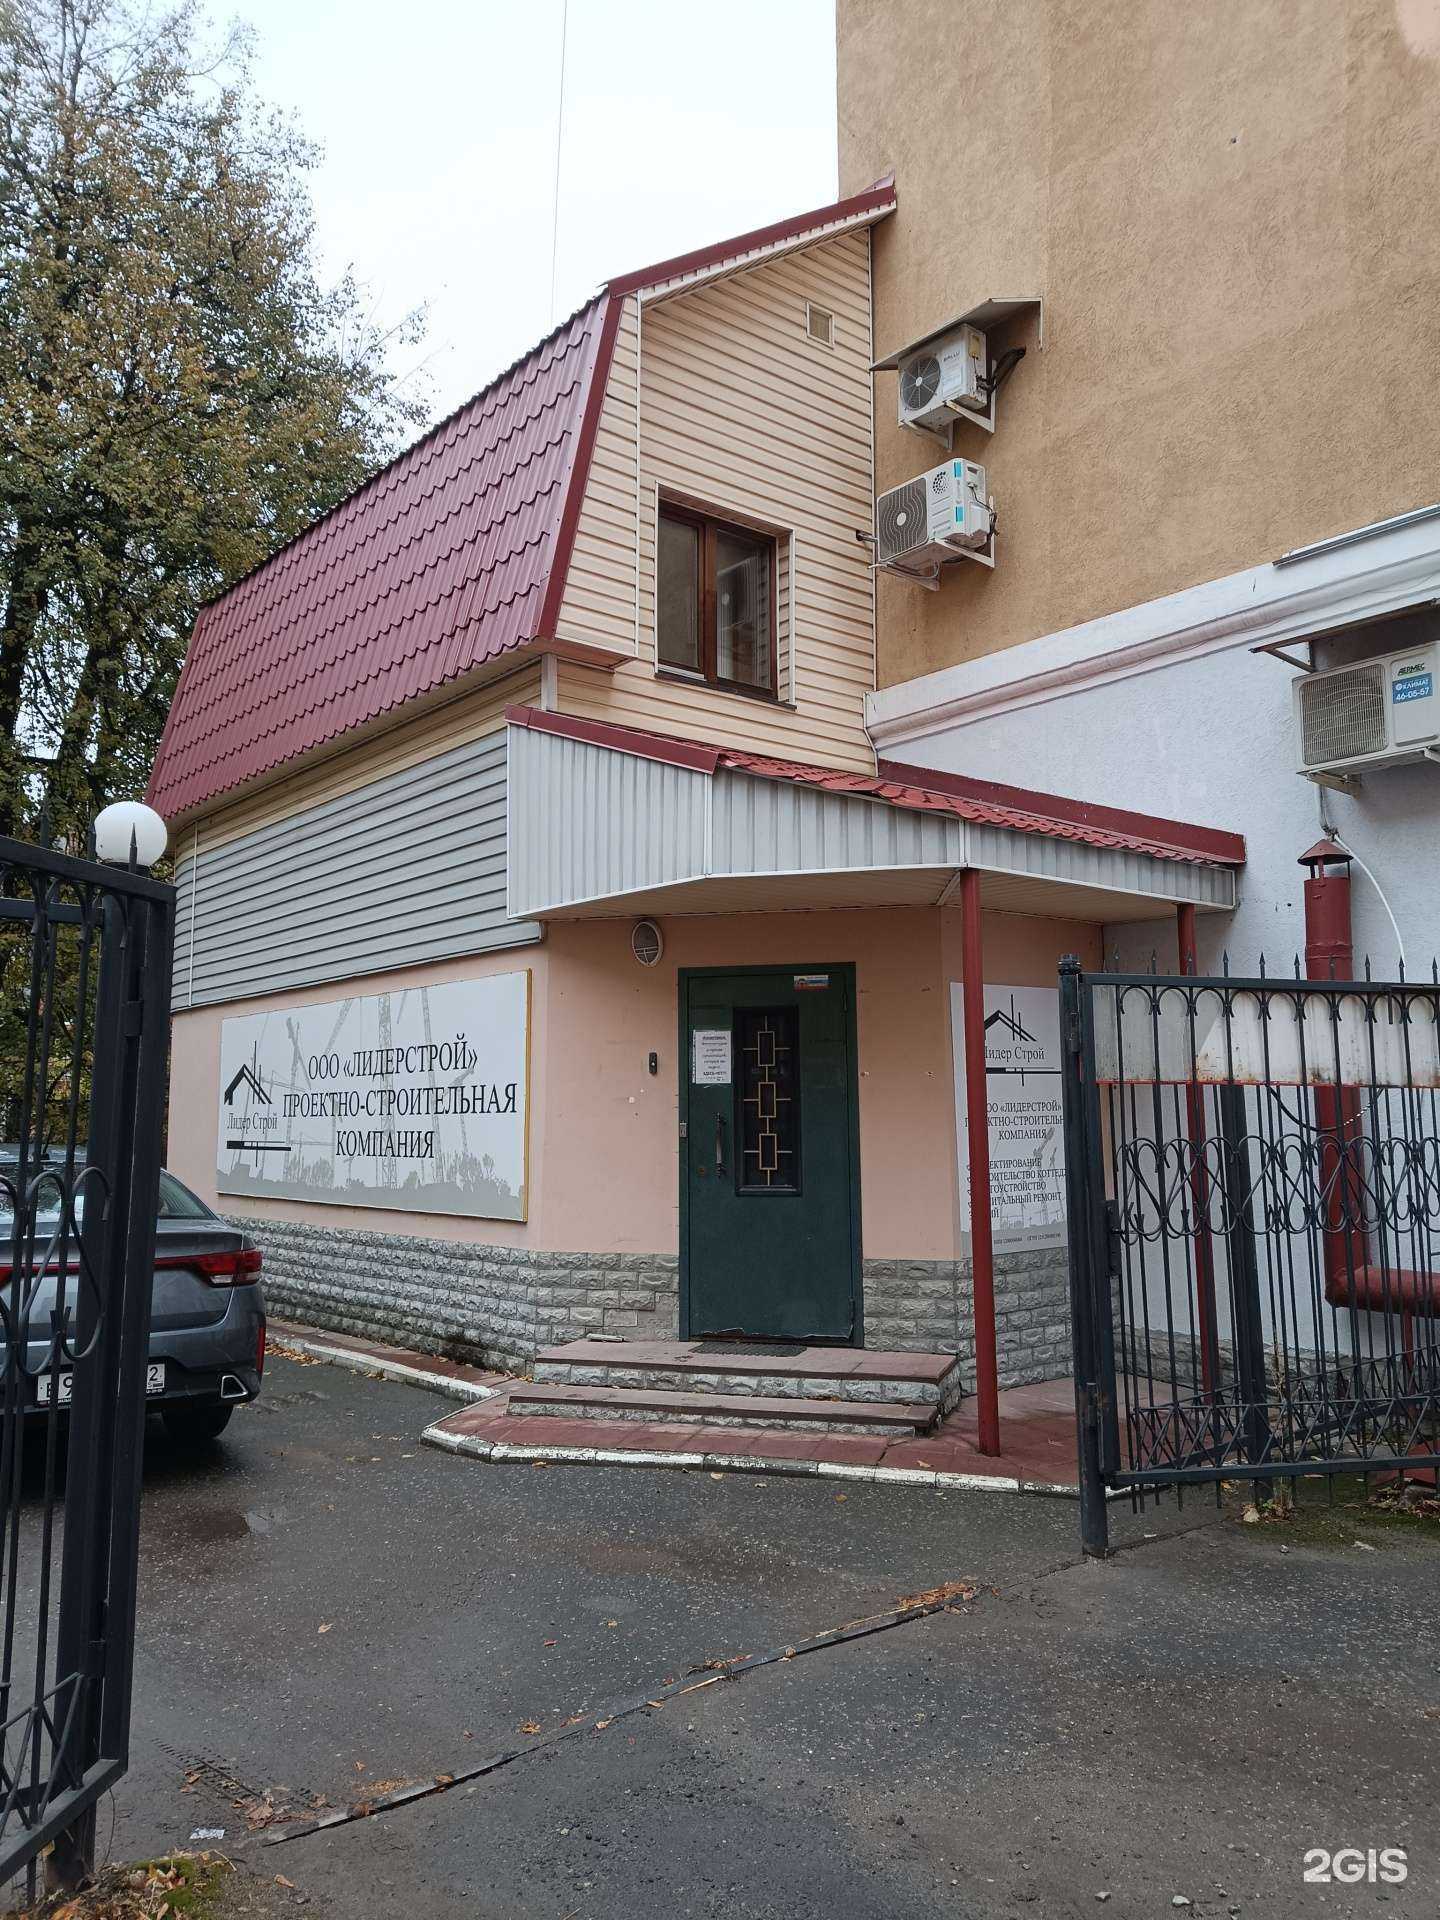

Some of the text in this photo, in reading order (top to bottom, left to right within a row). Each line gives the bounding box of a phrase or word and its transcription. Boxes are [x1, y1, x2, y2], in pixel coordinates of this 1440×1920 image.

[308, 1032, 478, 1081] ООО «ЛИДЕРСТРОЙ»
[1014, 1046, 1045, 1062] Строй
[282, 1083, 518, 1118] ПРОЕКТНО-СТРОИТЕЛЬНАЯ
[986, 1102, 999, 1113] ОО
[227, 1112, 278, 1134] Лидер Строй
[999, 1128, 1047, 1140] КОМПАНИЯ
[335, 1130, 435, 1159] КОМПАНИЯ
[989, 1157, 1042, 1170] ЕКТИРОВАНИЕ
[1034, 1191, 1062, 1203] РЕМОНТ
